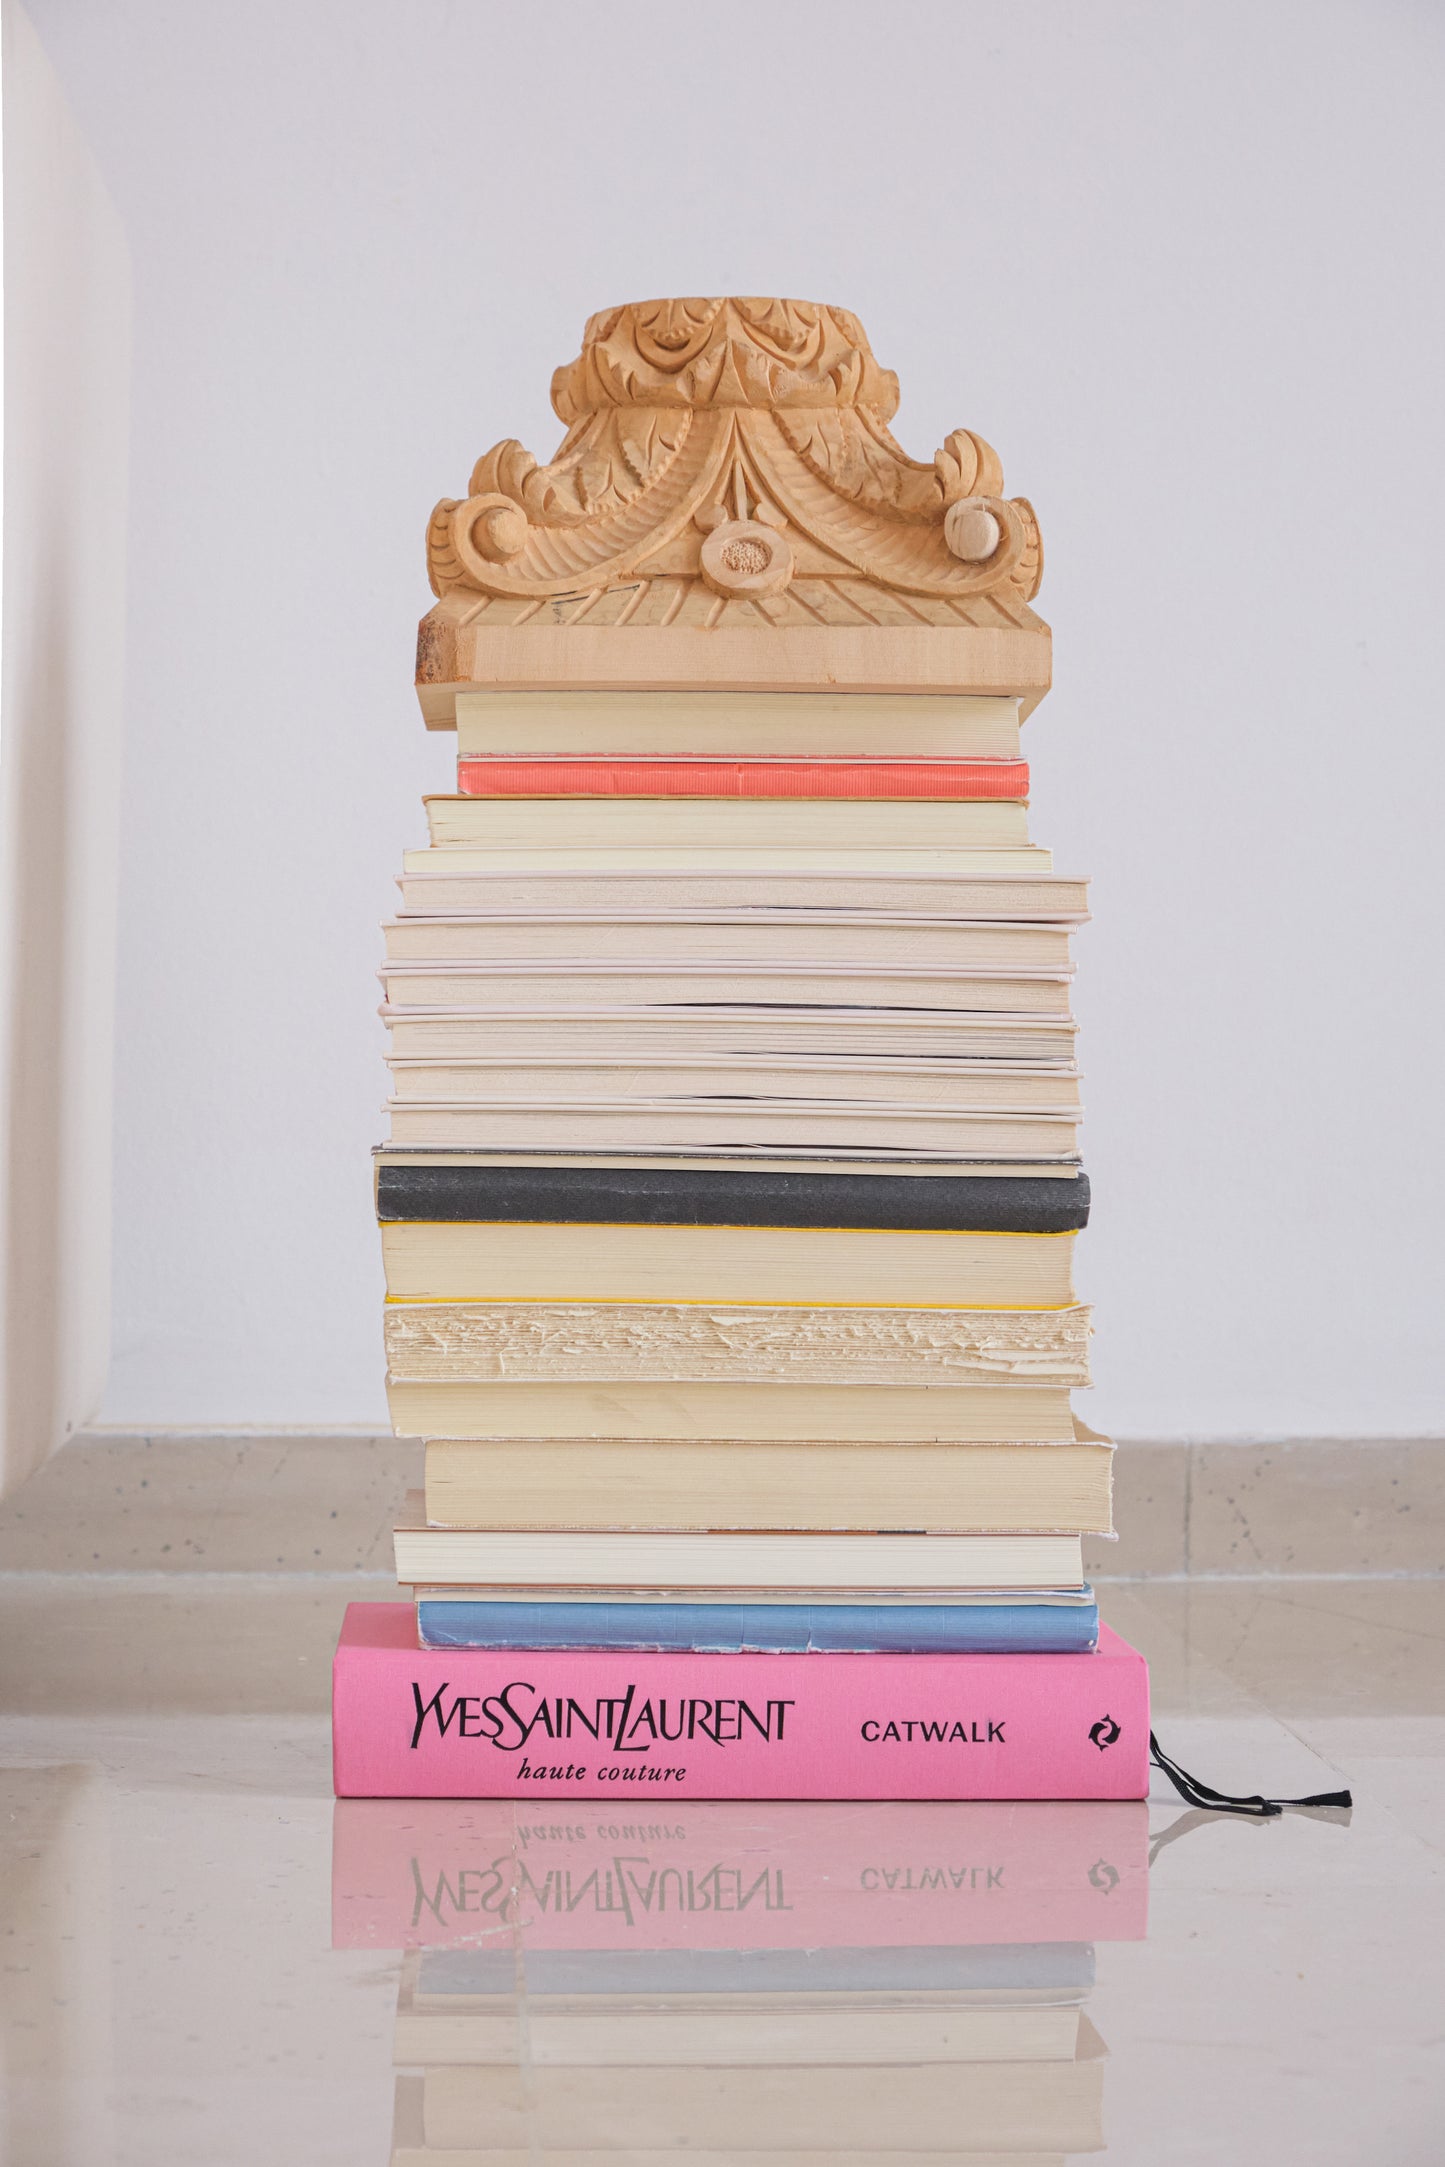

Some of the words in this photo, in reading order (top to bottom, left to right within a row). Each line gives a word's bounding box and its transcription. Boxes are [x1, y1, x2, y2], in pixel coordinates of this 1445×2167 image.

[860, 1720, 1006, 1743] CATWALK
[516, 1757, 587, 1781] haute
[597, 1765, 687, 1782] couture
